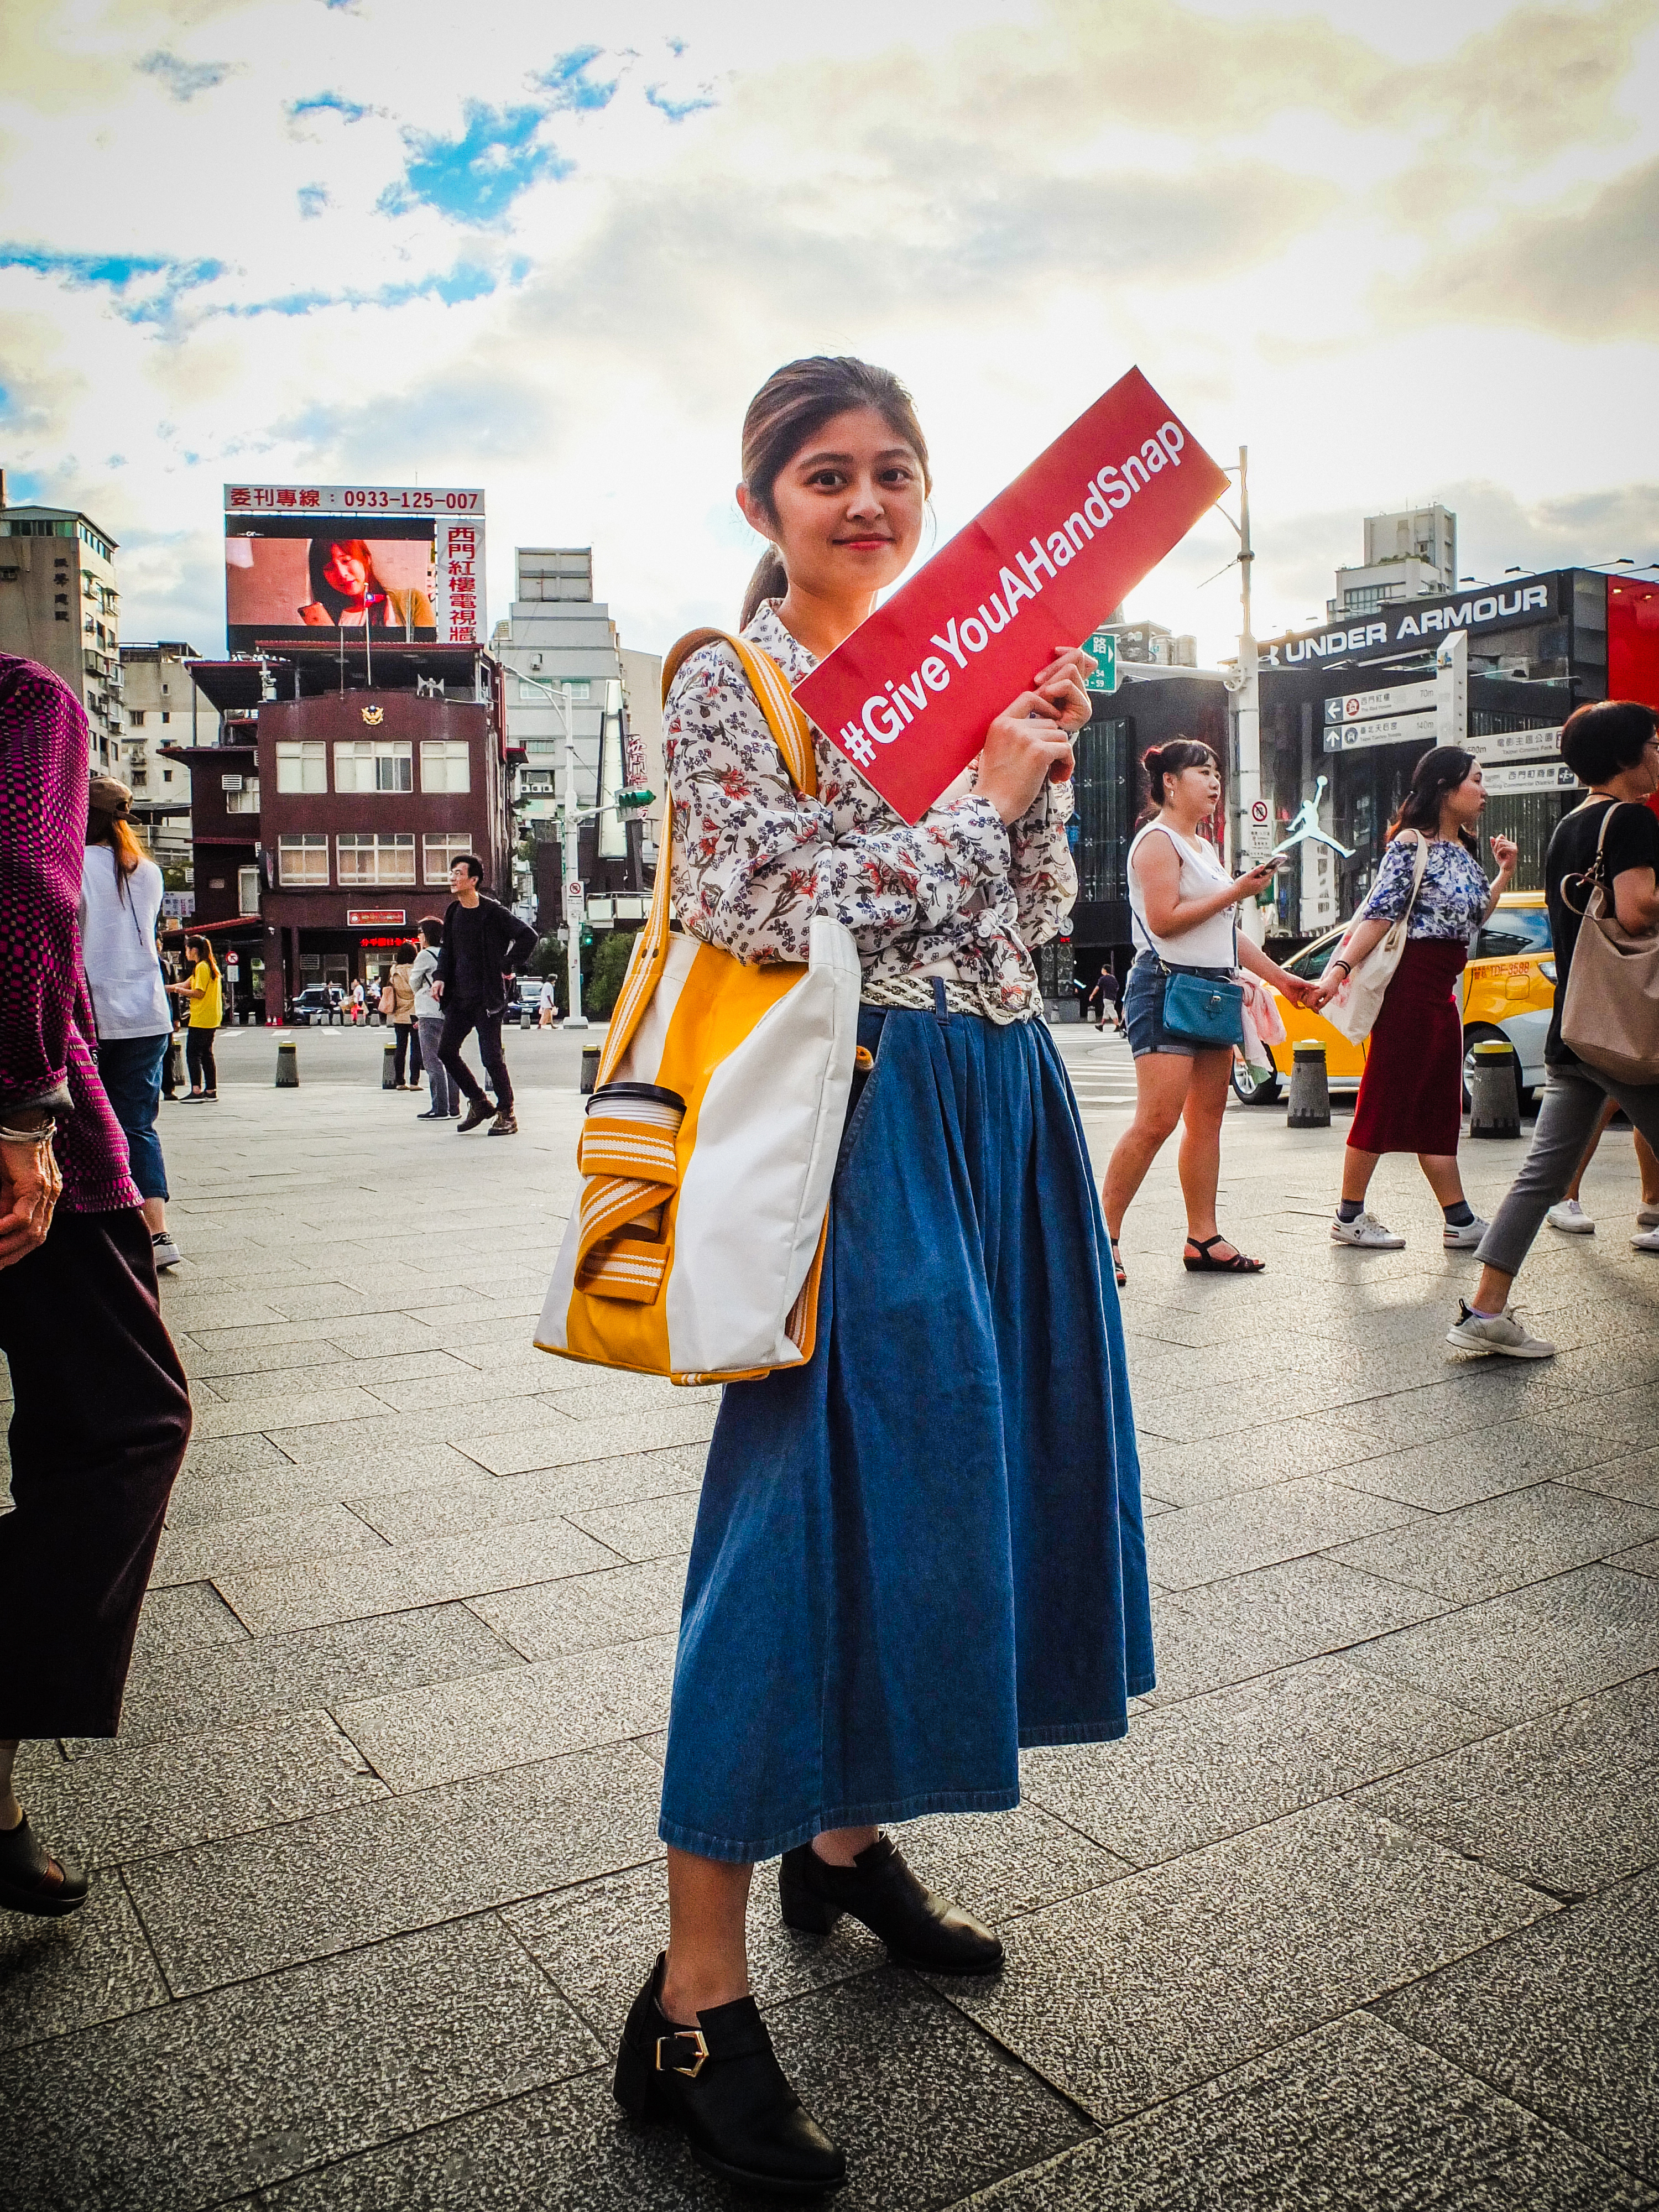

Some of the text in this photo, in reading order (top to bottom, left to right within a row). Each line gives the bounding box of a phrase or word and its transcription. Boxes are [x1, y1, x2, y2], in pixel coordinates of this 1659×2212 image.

[344, 490, 478, 509] 0933-125-007
[447, 526, 477, 641] 西門紅樓電視牆
[840, 421, 1185, 768] #GiveYouAHandSnap
[1093, 637, 1107, 654] 路
[1285, 585, 1548, 663] UNDER ARMOUR
[1420, 689, 1434, 698] 70m
